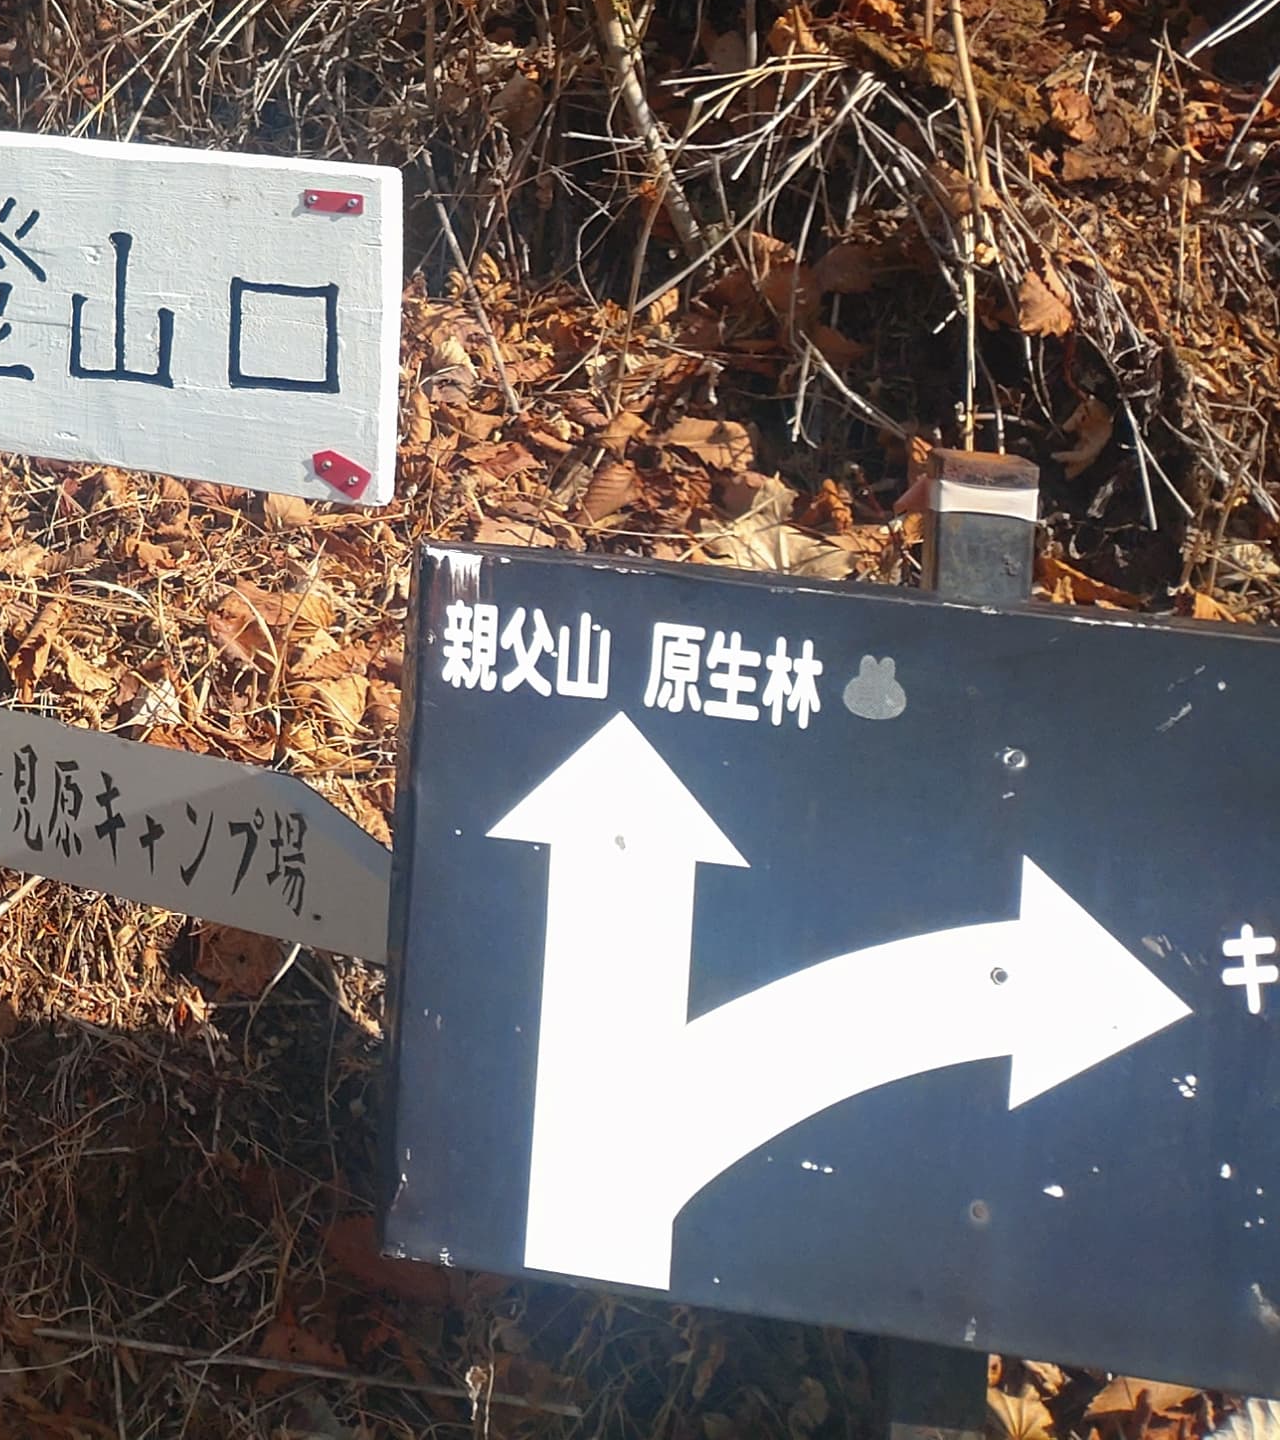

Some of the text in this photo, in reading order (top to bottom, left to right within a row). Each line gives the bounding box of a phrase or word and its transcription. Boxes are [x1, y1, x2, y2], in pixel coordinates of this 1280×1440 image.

[440, 598, 824, 730] 親父山 原生林
[1221, 922, 1279, 1015] キ
